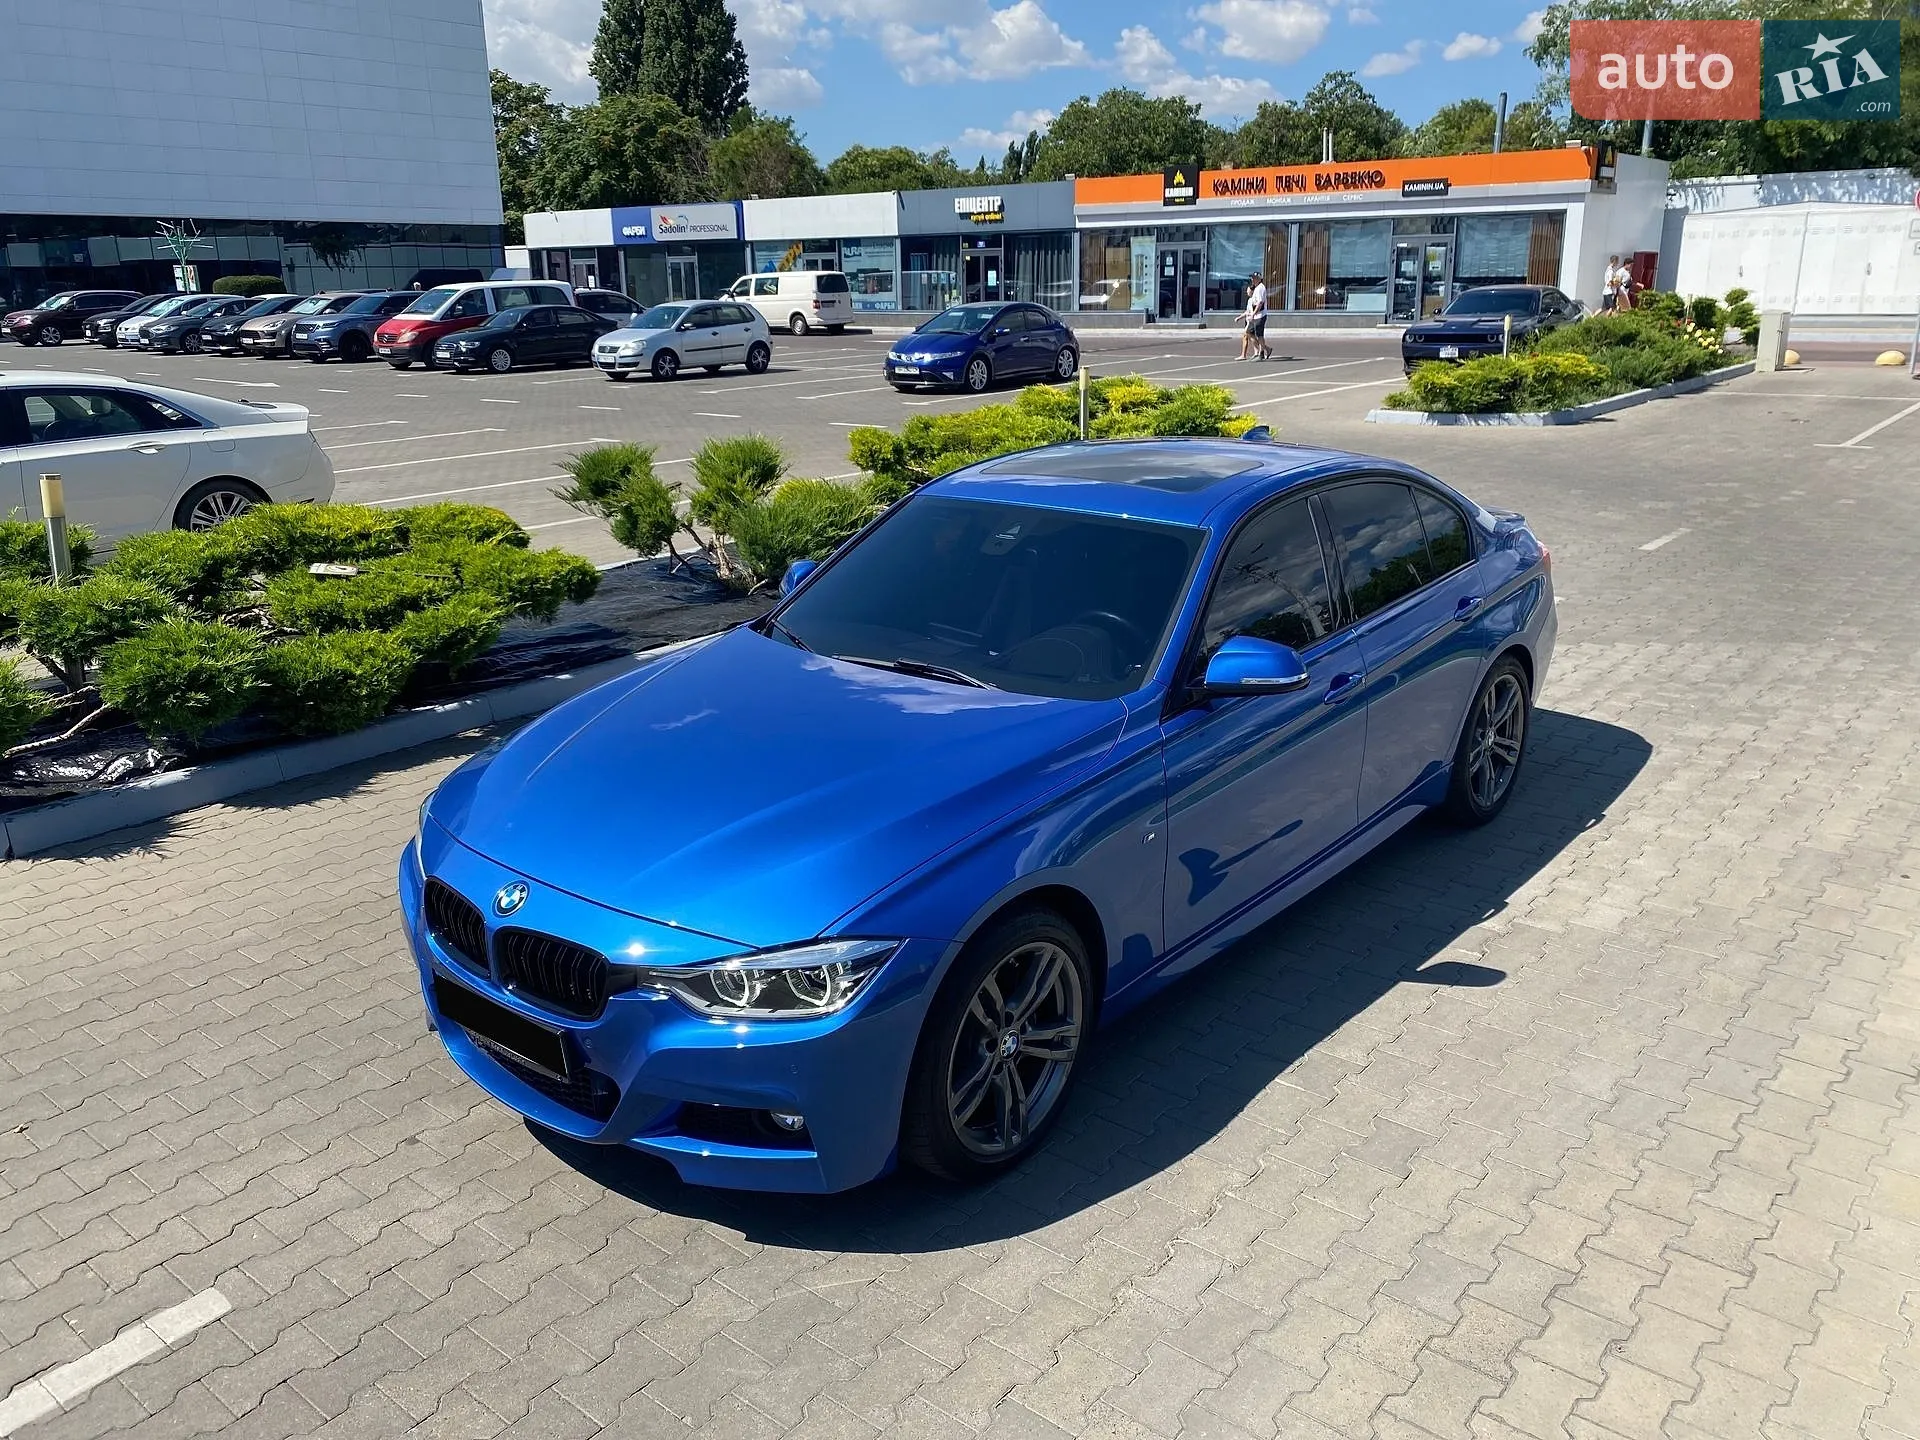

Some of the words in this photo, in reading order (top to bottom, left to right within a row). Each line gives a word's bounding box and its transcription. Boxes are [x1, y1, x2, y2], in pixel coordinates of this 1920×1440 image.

[1212, 176, 1267, 196] КАМІНИ
[1275, 173, 1307, 193] ПЕЧІ
[1404, 182, 1445, 192] KAMININ.UA
[954, 195, 1001, 214] ЕПІЦЕНТР
[658, 224, 687, 234] Sadolin
[689, 223, 729, 234] PROFESSIONAL
